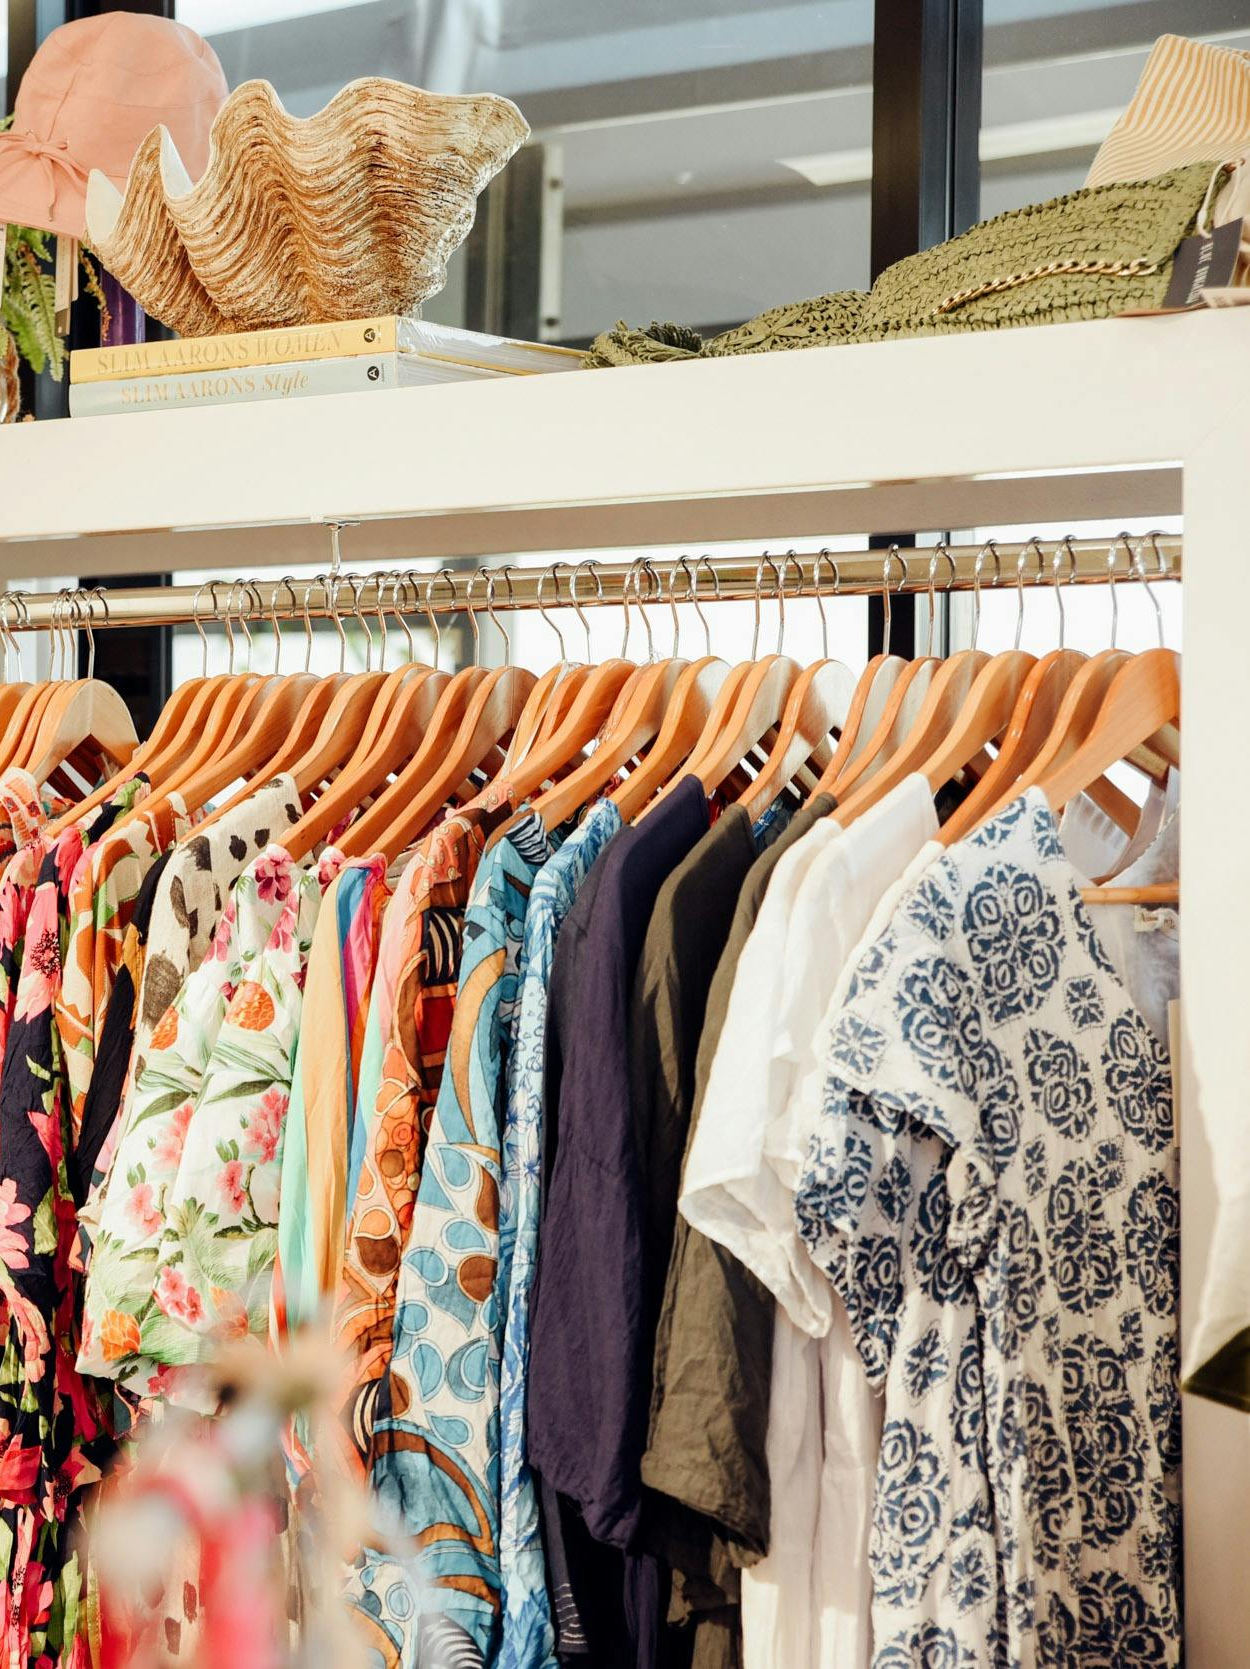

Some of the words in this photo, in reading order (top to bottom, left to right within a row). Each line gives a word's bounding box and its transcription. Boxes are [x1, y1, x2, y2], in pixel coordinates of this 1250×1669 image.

[97, 348, 150, 375] SLIM
[157, 337, 250, 370] AARONS
[254, 326, 344, 358] WOMEN
[121, 381, 169, 405] SLIM
[175, 374, 256, 400] AARONS
[262, 369, 309, 396] Style
